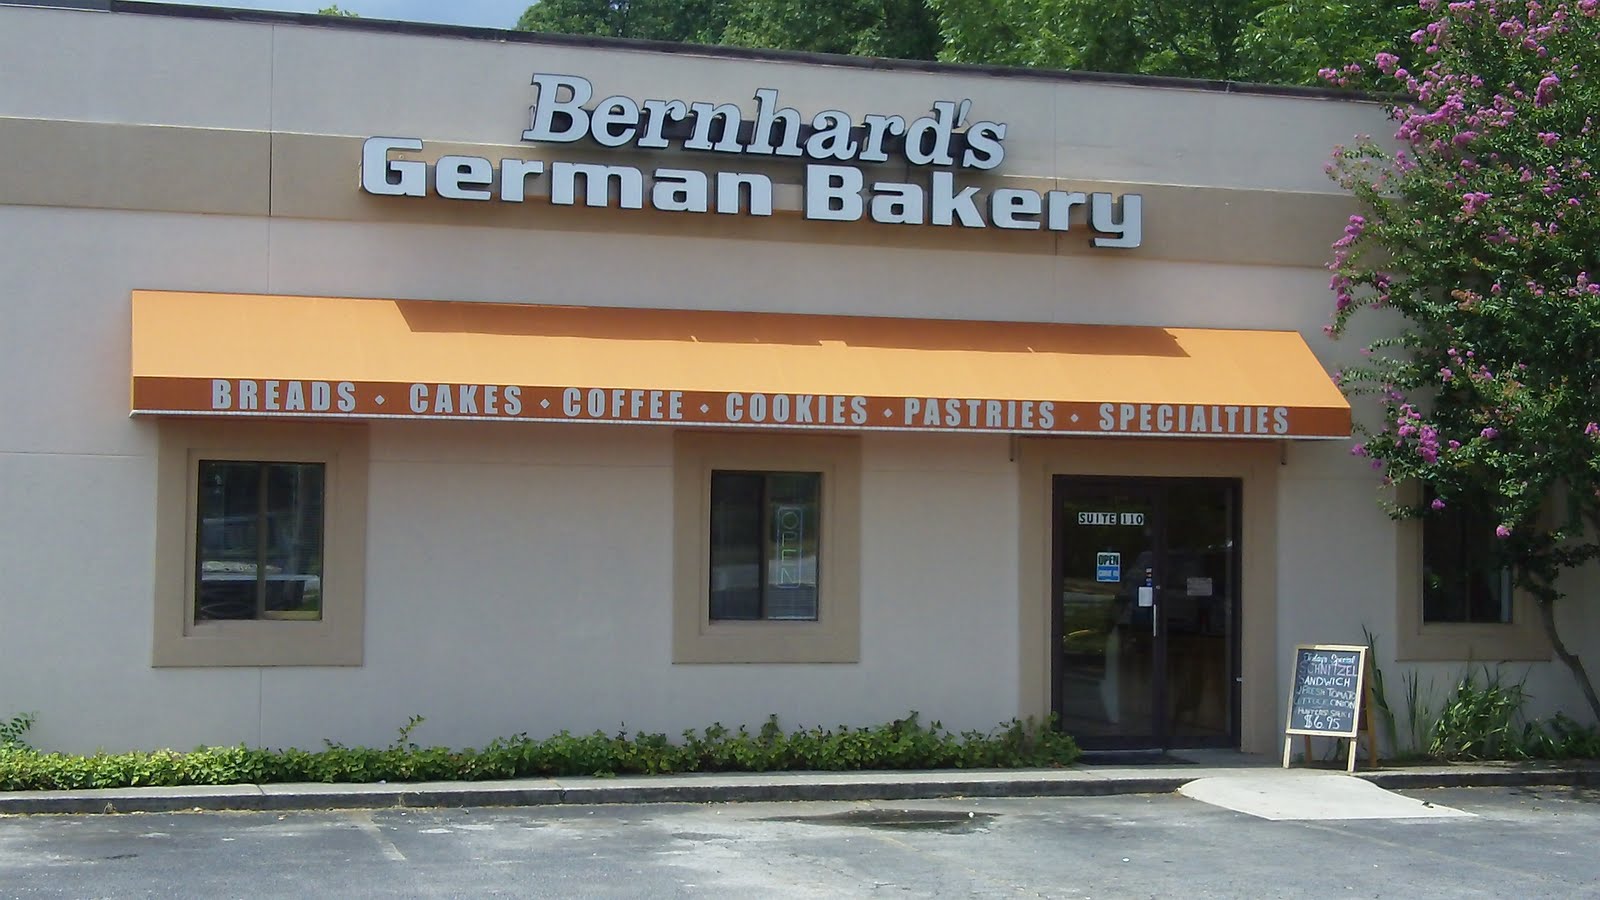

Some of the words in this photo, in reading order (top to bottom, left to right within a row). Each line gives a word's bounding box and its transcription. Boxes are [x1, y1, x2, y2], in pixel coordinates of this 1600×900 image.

[521, 73, 1007, 170] Bernhard's
[362, 136, 773, 216] German
[803, 164, 1143, 249] Bakery
[211, 379, 356, 412] BREADS
[409, 383, 523, 416] CAKES
[562, 387, 684, 420] COFFEE
[725, 392, 868, 425] COOKIES
[904, 397, 1055, 429] PASTRIES
[1099, 402, 1289, 434] SPECIALTIES
[1079, 513, 1115, 525] SUITE
[1122, 513, 1144, 525] 110
[1098, 554, 1119, 566] OPEN
[1299, 662, 1357, 677] SCHNITZEL
[1299, 675, 1351, 688] SANDWICH
[1304, 715, 1341, 730] $6.95
